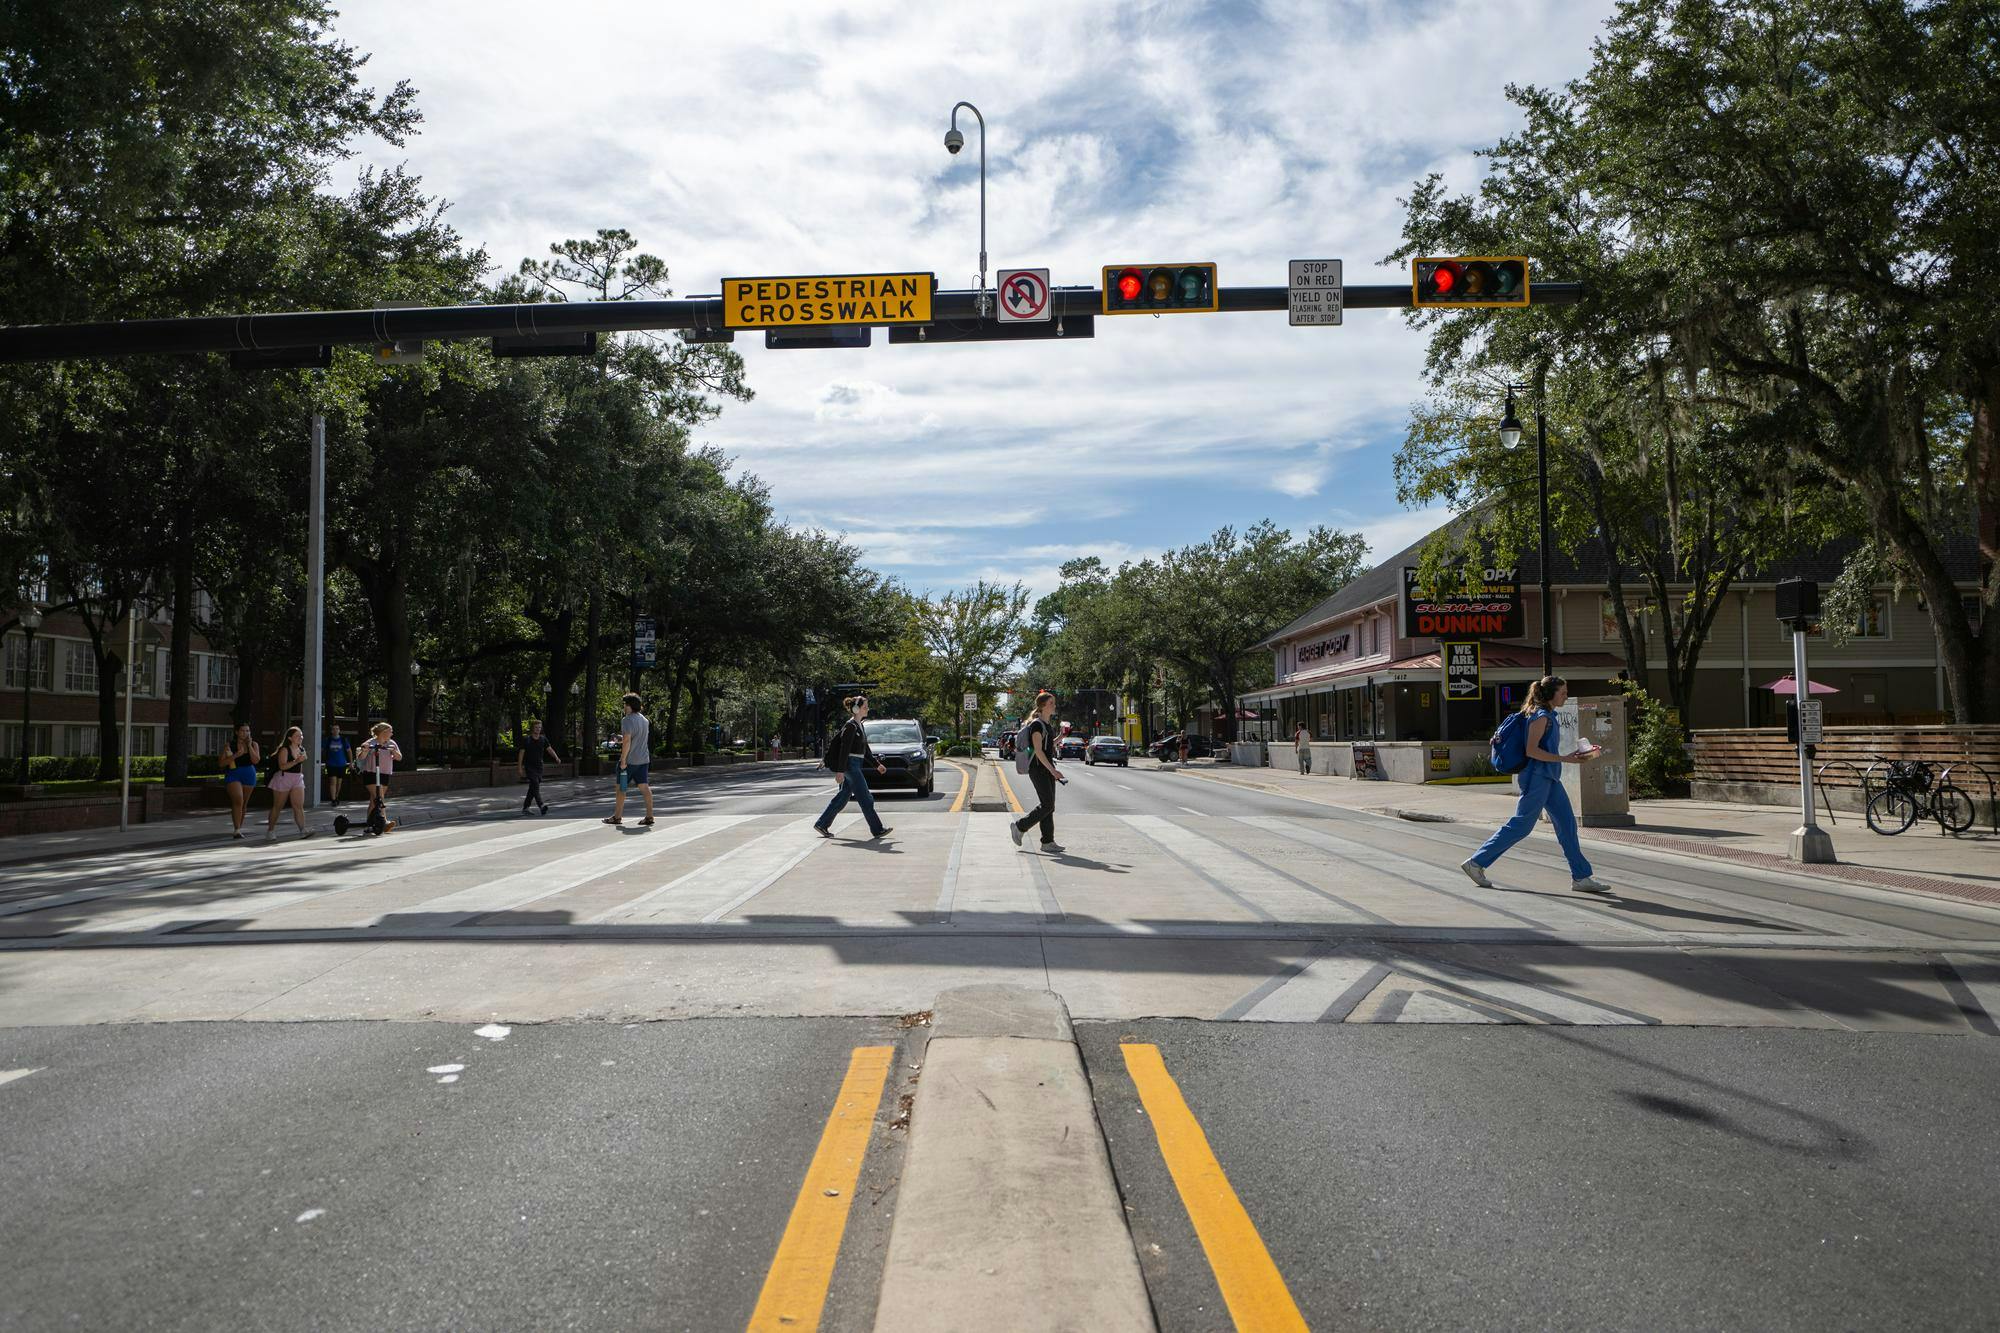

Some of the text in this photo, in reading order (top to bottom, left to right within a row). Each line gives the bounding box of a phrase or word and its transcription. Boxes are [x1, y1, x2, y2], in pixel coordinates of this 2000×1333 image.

[1303, 263, 1328, 273] STOP
[1296, 275, 1335, 286] ON RED
[738, 279, 917, 301] PEDESTRIAN
[1292, 292, 1340, 302] YIELD ON
[740, 300, 915, 323] CROSSWALK
[1292, 304, 1339, 312] FLASHING RED
[1320, 314, 1336, 322] STOP
[1482, 568, 1518, 582] OPY
[1415, 602, 1512, 613] SUSHI-2-GO
[1454, 645, 1472, 655] WE
[1452, 655, 1475, 664] ARE
[1449, 665, 1478, 675] OPEN
